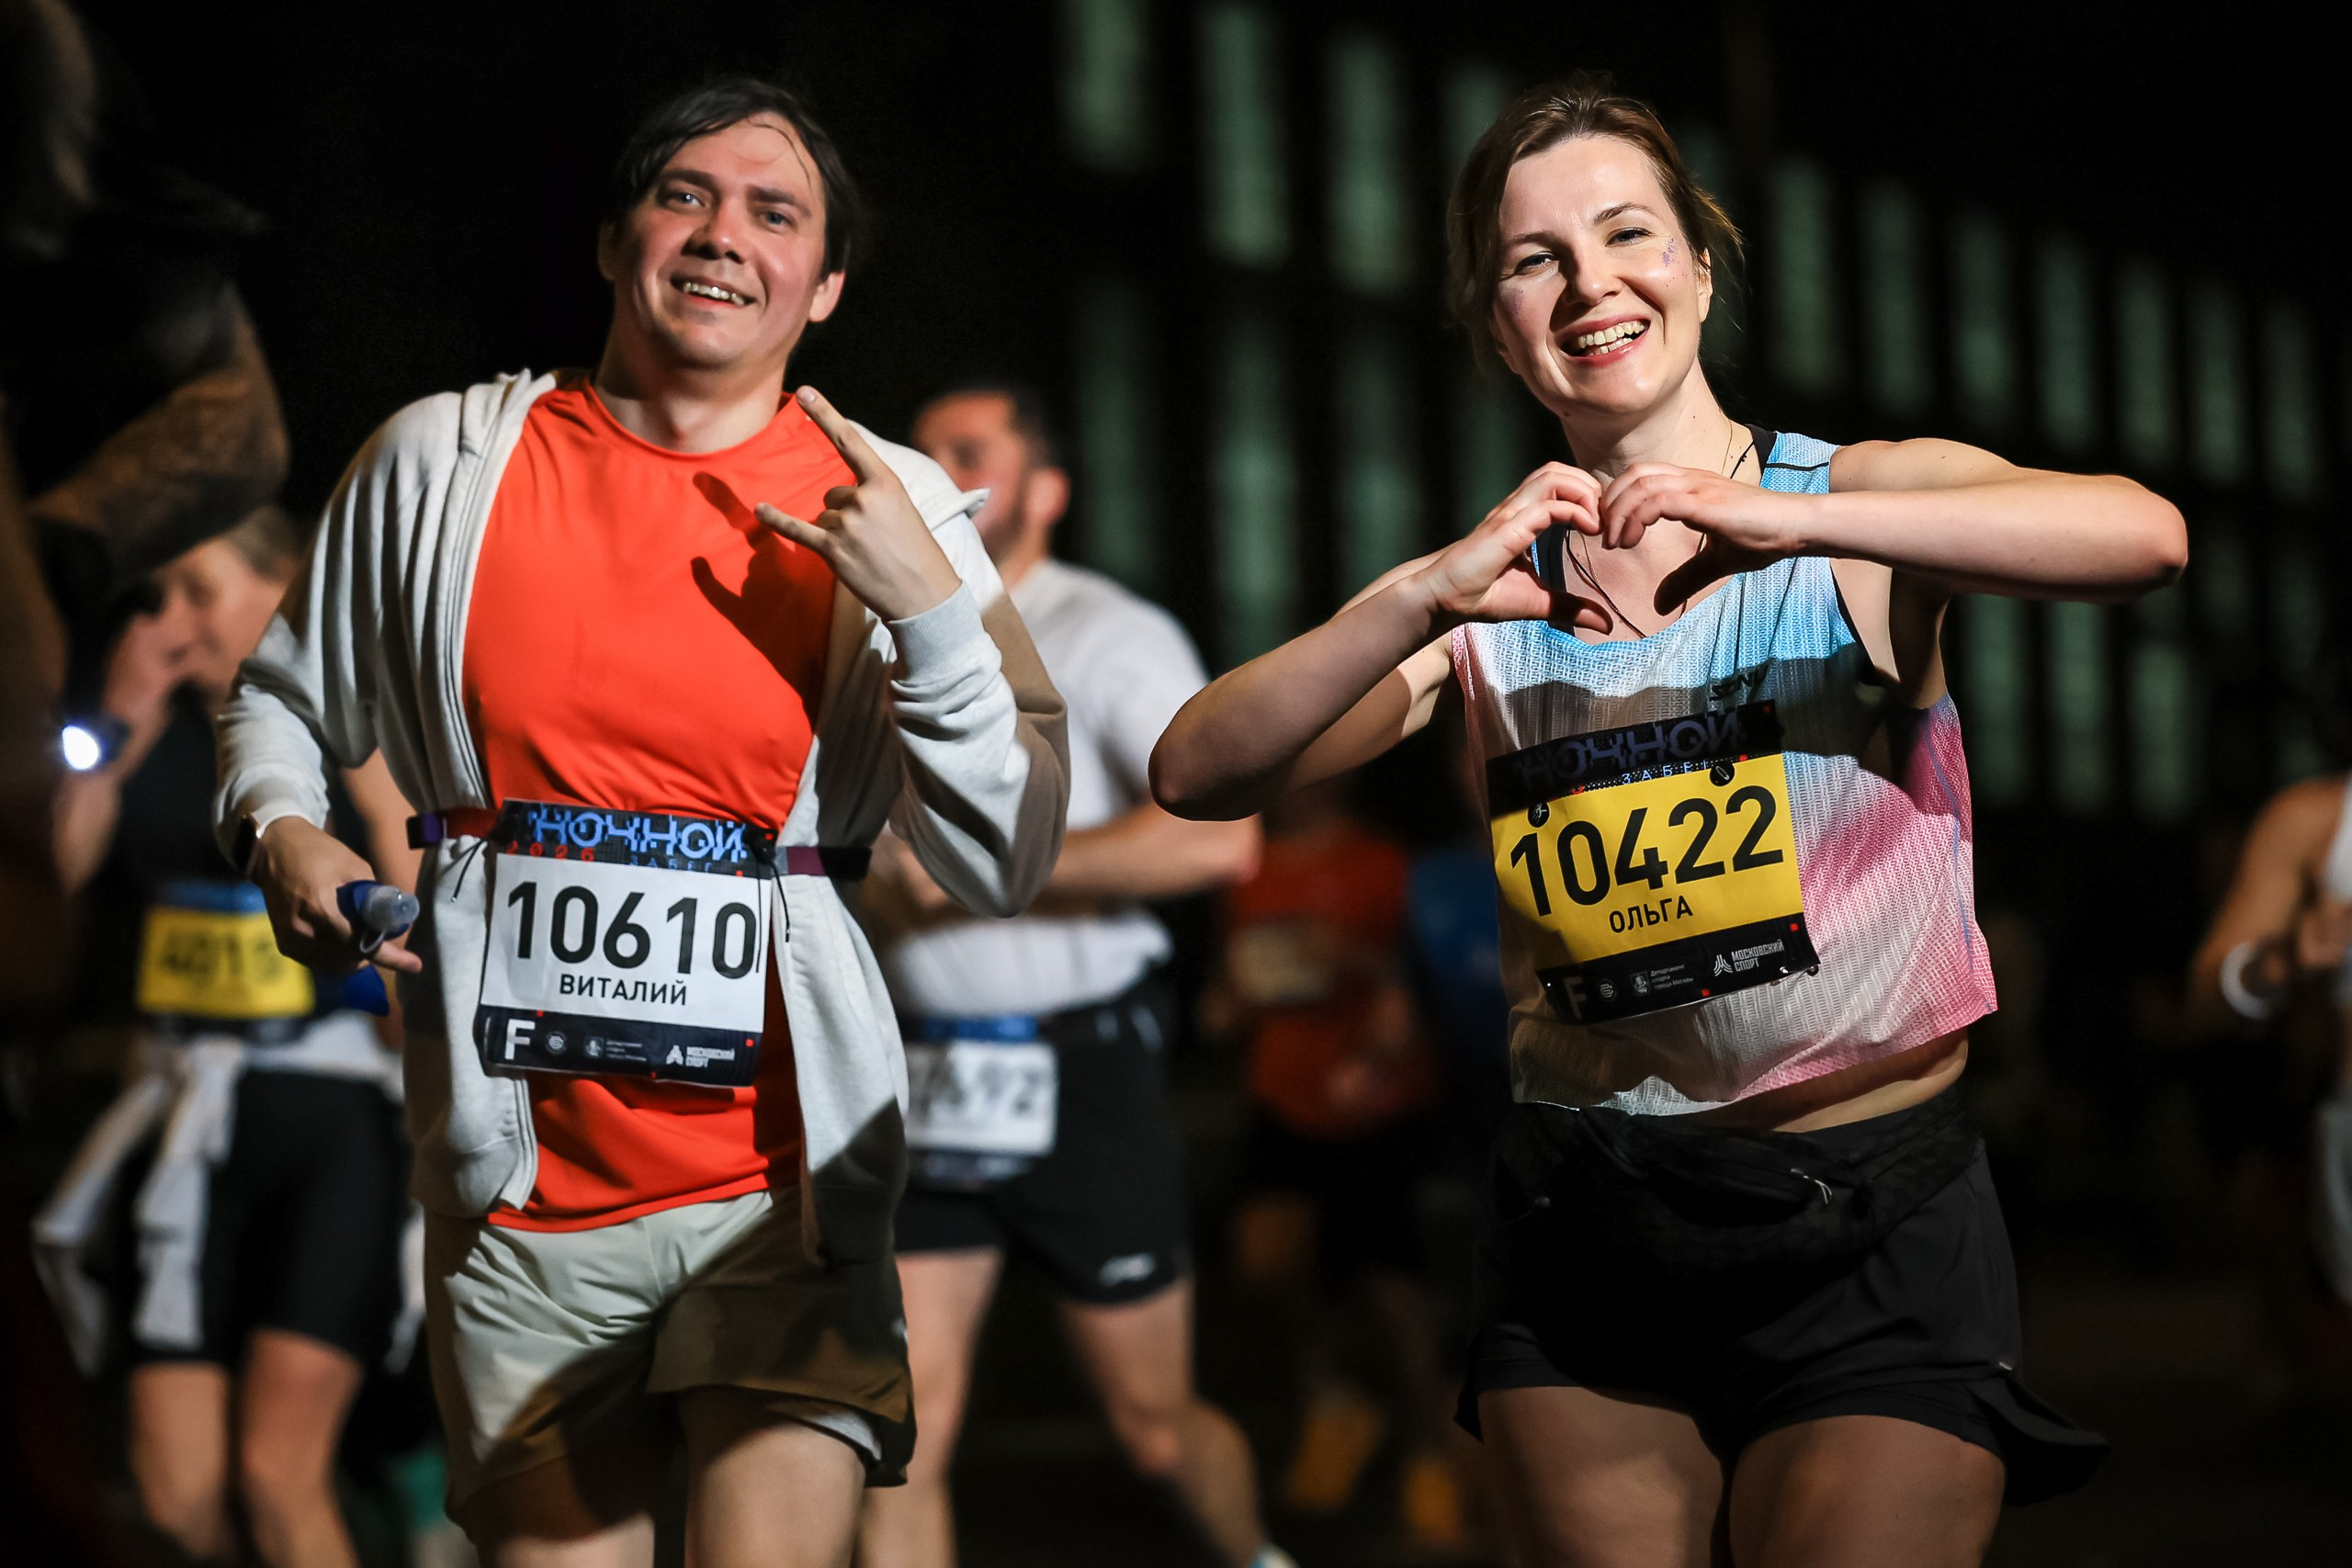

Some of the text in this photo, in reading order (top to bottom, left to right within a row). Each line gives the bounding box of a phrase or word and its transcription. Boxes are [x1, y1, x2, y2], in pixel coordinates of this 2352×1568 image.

[527, 804, 748, 863] НОЧНОЙ
[1510, 785, 1784, 918] 10422
[507, 881, 757, 979] 10610
[1609, 895, 1694, 934] ОЛЬГА
[1731, 939, 1785, 962] МОСКОВСКИЙ
[1733, 959, 1760, 973] СПОРТ
[559, 974, 687, 1006] ВИТАЛИЙ
[1565, 976, 1588, 1020] F
[504, 1019, 536, 1060] F
